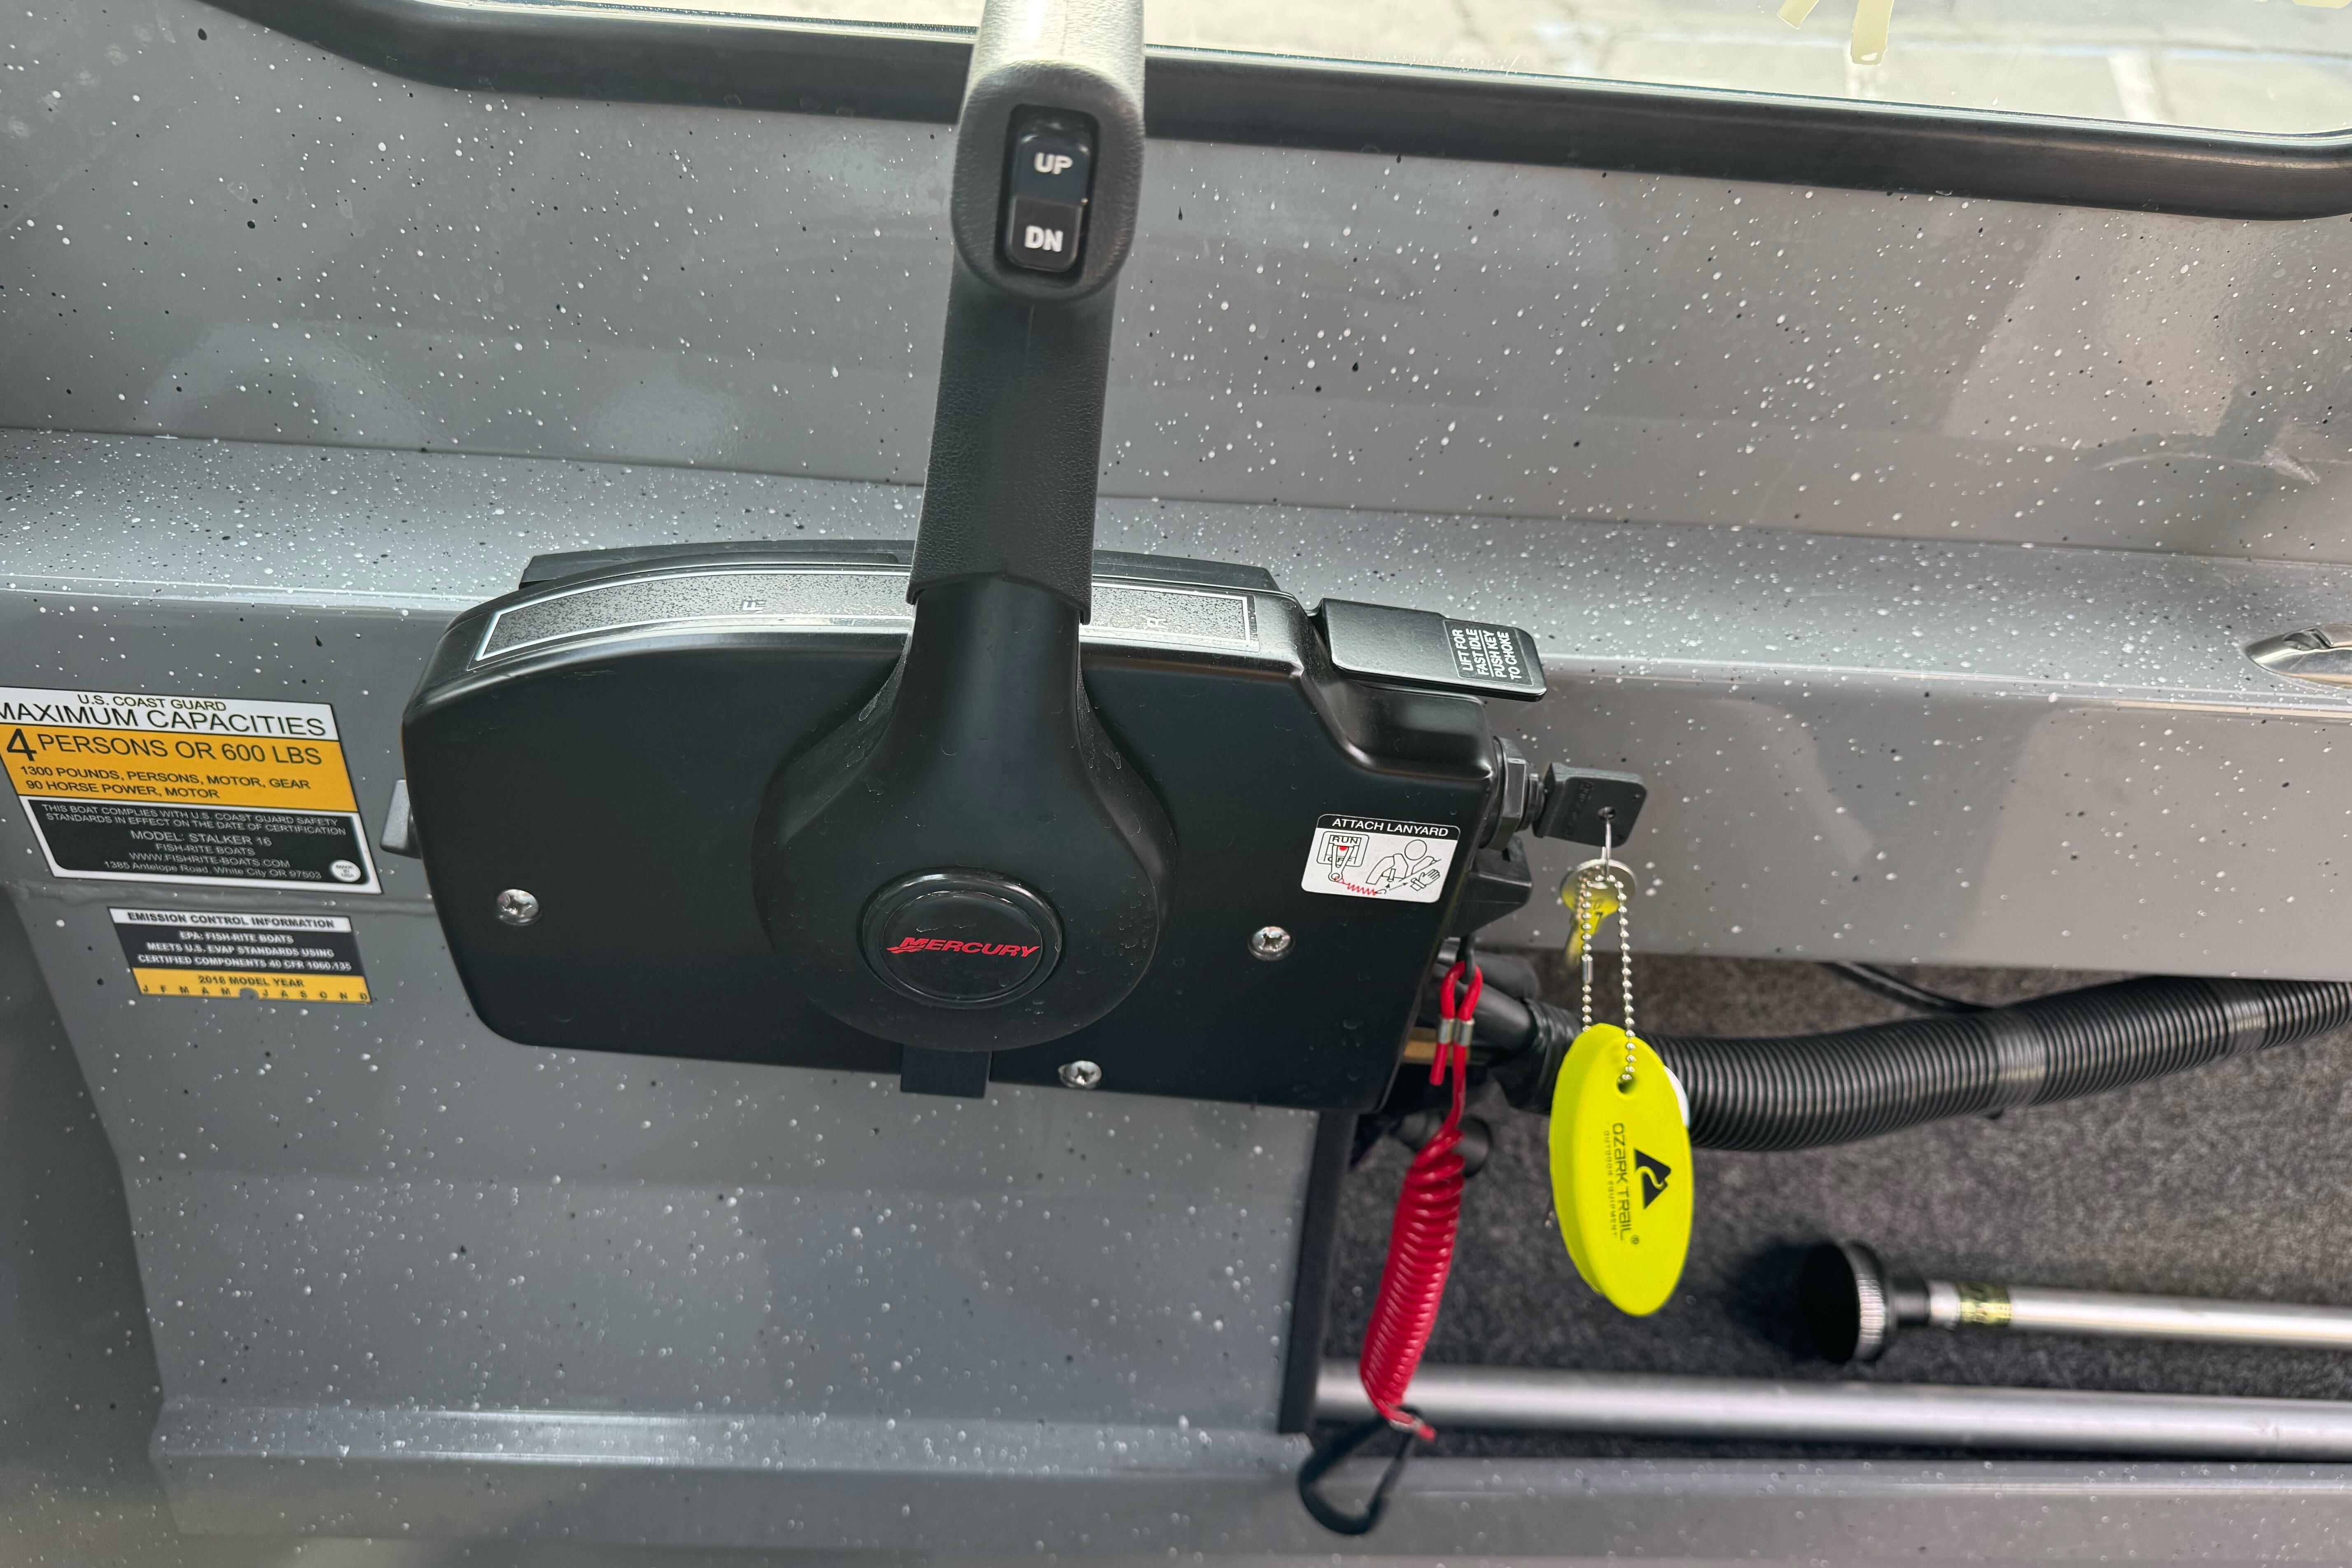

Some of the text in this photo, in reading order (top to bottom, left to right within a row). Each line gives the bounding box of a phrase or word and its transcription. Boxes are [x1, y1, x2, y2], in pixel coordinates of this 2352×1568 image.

[1034, 152, 1073, 174] UP
[1025, 225, 1063, 252] DN
[1452, 629, 1474, 671] LIFT FOR
[1466, 628, 1489, 675] FAST IDLE
[1483, 630, 1507, 677] PUSH KEY
[1497, 631, 1522, 679] TO CHOKE
[77, 694, 226, 711] U.S. COAST GUARD
[147, 710, 326, 736] CAPACITIES
[7, 728, 322, 765] 4 PERSONS OR 600 LBS
[21, 766, 311, 789] 1300 POUNDS, PERSONS, MOTOR, GEAR
[26, 780, 220, 798] 90 HORSE POWER, MOTOR
[42, 804, 337, 826] THIS BOAT COMPLIES WITH U.S. COAST GUARD SAFETY
[47, 813, 112, 823] STANDARDS
[128, 817, 170, 826] EFFECT
[191, 820, 214, 828] THE
[217, 822, 245, 831] DATE
[265, 824, 346, 836] CERTIFICATION
[1332, 818, 1449, 836] ATTACH LANYARD
[130, 830, 272, 847] MODEL: STALKER 16
[155, 843, 255, 856] FISH-RITE BOATS
[104, 860, 130, 869] 1385
[132, 862, 177, 873] Antelope
[213, 866, 244, 875] White
[247, 868, 266, 878] City
[269, 869, 287, 877] OR
[289, 870, 322, 880] 97503
[127, 912, 334, 928] EMISSION CONTROL INFORMATION
[205, 931, 257, 943] FISH-RITE
[258, 934, 294, 944] BOATS
[887, 937, 1039, 957] MERCURY
[146, 942, 183, 952] MEETS
[208, 945, 235, 954] EVAP
[236, 946, 299, 957] STANDARDS
[300, 948, 334, 958] USING
[138, 954, 192, 965] CERTIFIED
[194, 956, 267, 968] COMPONENTS
[268, 959, 282, 968] 40
[282, 960, 305, 968] CFR
[179, 985, 189, 994] M
[221, 987, 231, 995] M
[282, 989, 288, 998] A
[229, 977, 270, 986] MODEL
[273, 978, 304, 987] YEAR
